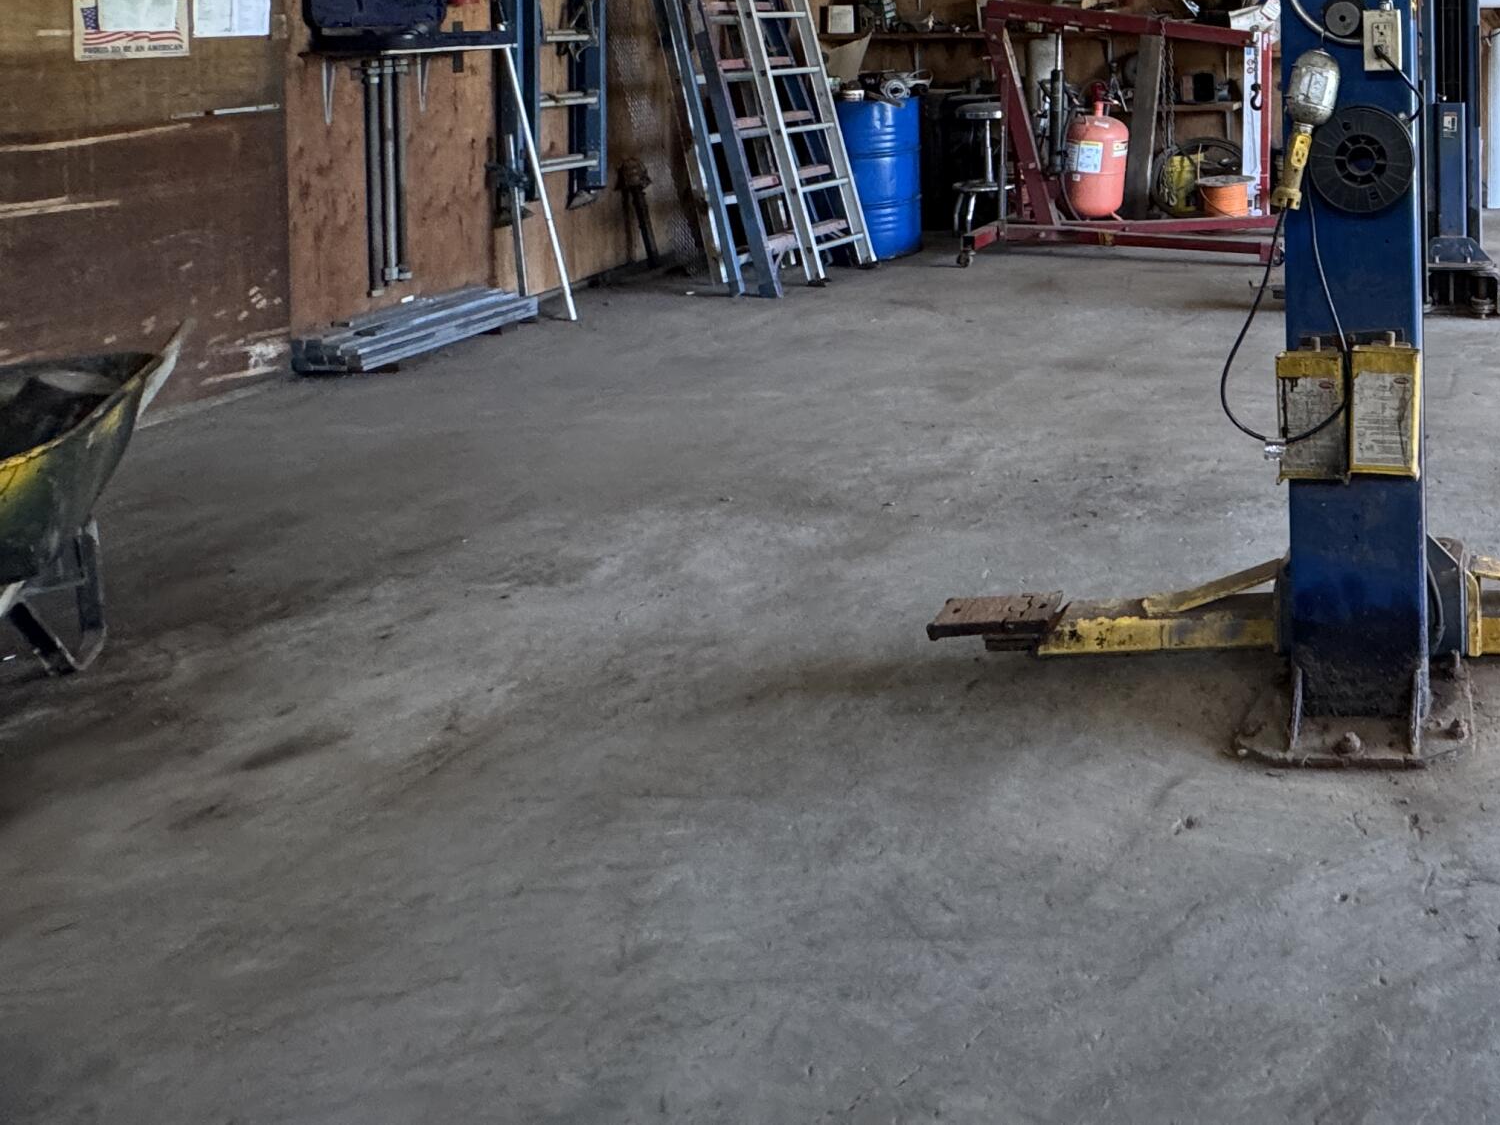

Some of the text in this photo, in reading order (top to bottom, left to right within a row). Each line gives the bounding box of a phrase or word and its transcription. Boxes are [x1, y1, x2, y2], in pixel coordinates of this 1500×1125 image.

[111, 45, 121, 53] TO
[123, 45, 132, 53] BE
[134, 44, 145, 52] AN
[147, 43, 184, 52] AMERICAN
